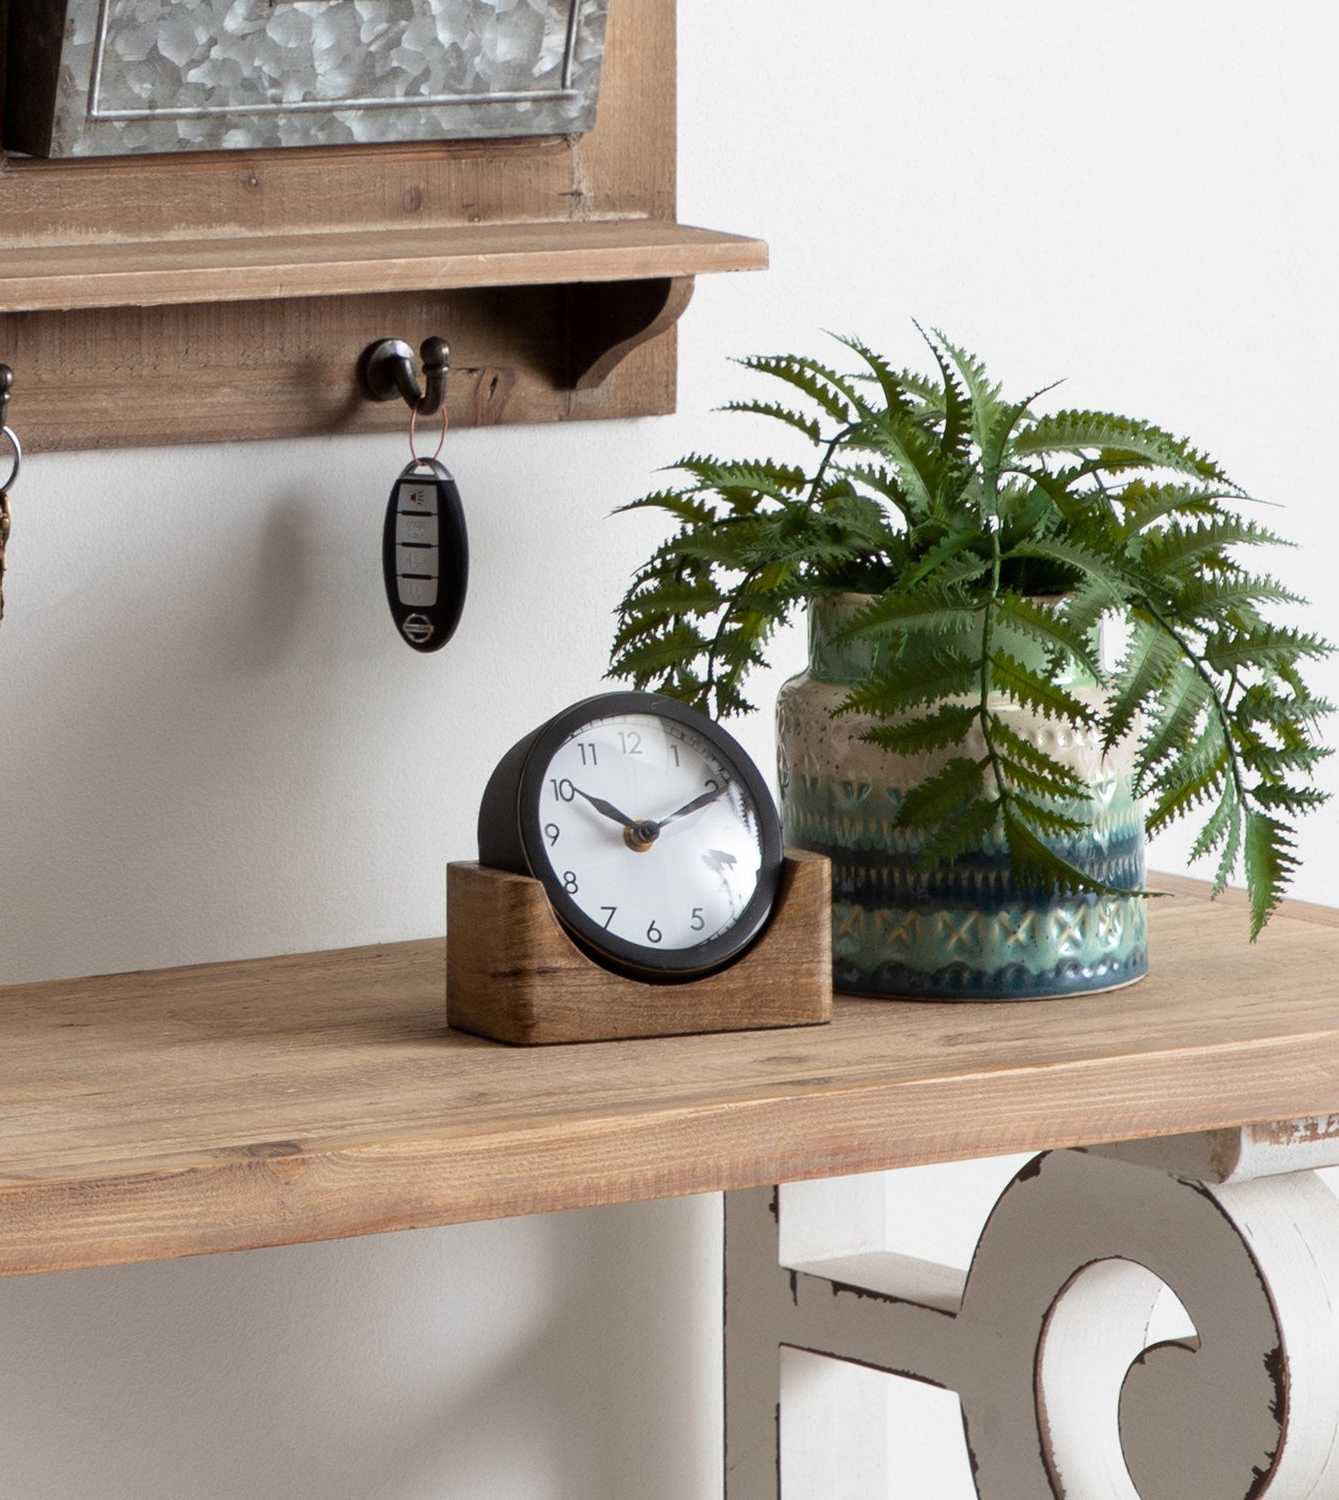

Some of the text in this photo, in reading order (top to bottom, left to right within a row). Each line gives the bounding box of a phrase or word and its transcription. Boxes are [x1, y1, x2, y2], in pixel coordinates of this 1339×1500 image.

[577, 743, 598, 766] 11
[618, 731, 643, 754] 12
[671, 744, 680, 768] 1
[550, 778, 575, 802] 10
[544, 823, 560, 847] 9
[563, 871, 579, 895] 8
[600, 906, 617, 930] 7
[690, 907, 705, 931] 5
[646, 919, 663, 944] 6
